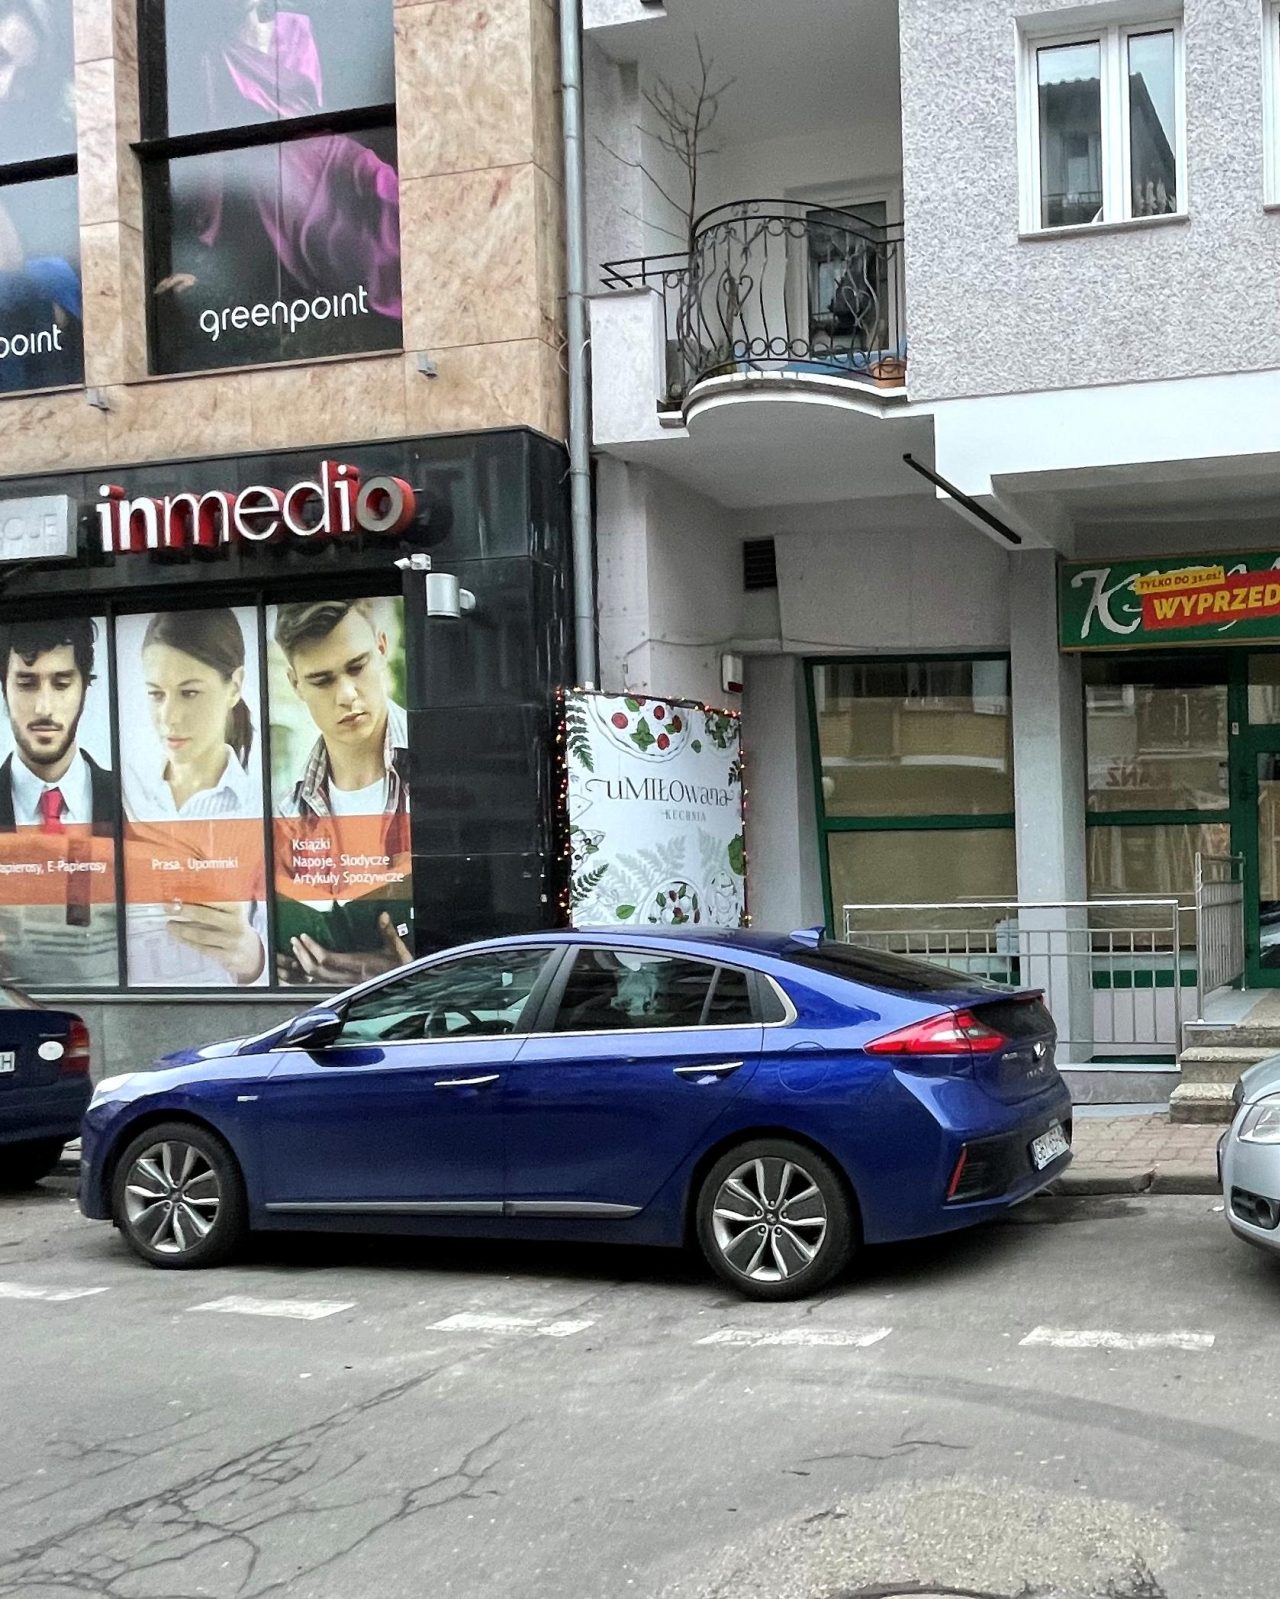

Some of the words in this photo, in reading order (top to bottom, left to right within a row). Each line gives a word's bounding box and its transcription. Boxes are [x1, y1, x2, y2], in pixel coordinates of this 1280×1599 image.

[200, 285, 369, 343] greenpoint
[97, 460, 414, 554] inmedio
[1139, 577, 1172, 589] TYLKO
[1174, 575, 1189, 586] DO
[187, 856, 239, 872] Upominki
[292, 856, 337, 870] Napoje,
[293, 871, 340, 887] Artykuły
